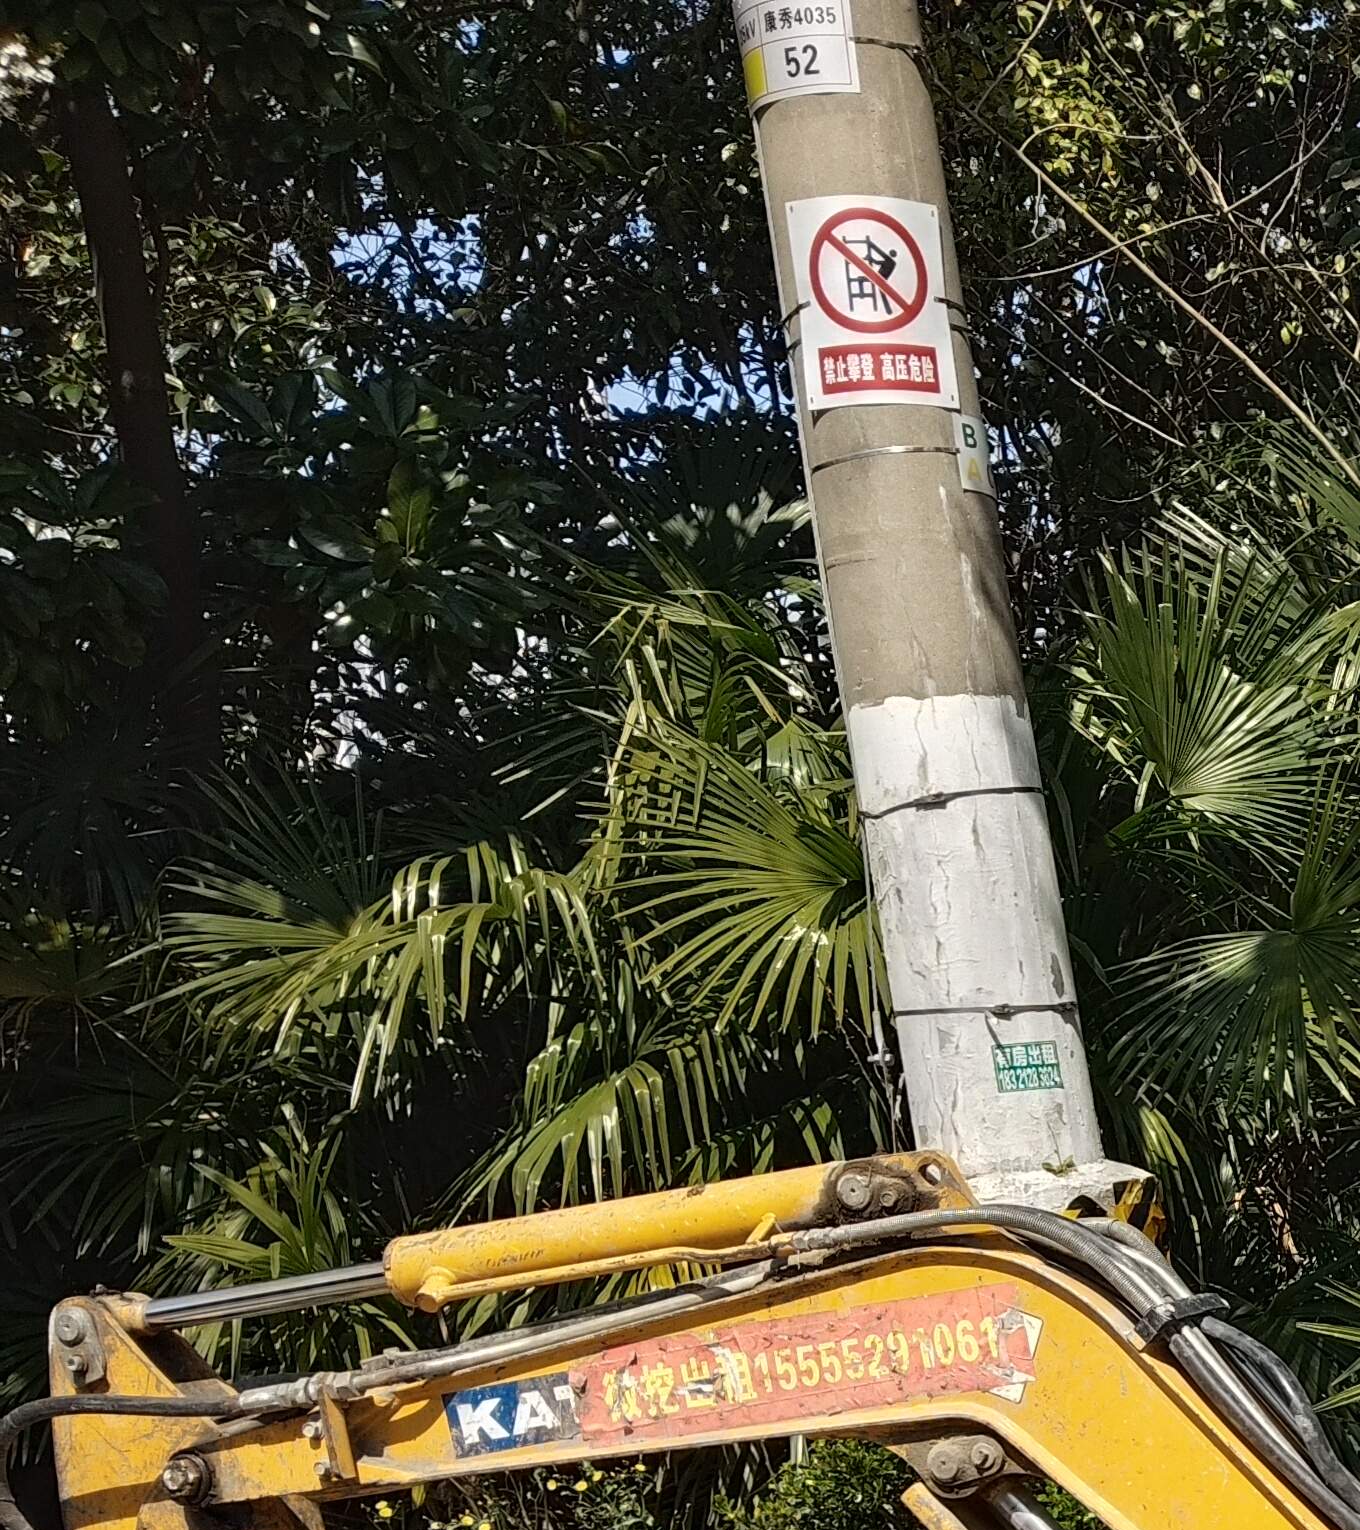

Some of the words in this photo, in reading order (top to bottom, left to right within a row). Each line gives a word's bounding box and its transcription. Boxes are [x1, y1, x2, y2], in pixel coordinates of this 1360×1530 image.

[763, 6, 836, 33] 康秀4035
[784, 43, 820, 78] 52
[823, 352, 875, 385] 禁止攀登
[880, 352, 936, 383] 高压危险
[961, 422, 978, 449] B
[966, 457, 982, 481] A
[995, 1043, 1058, 1069] 有房出租
